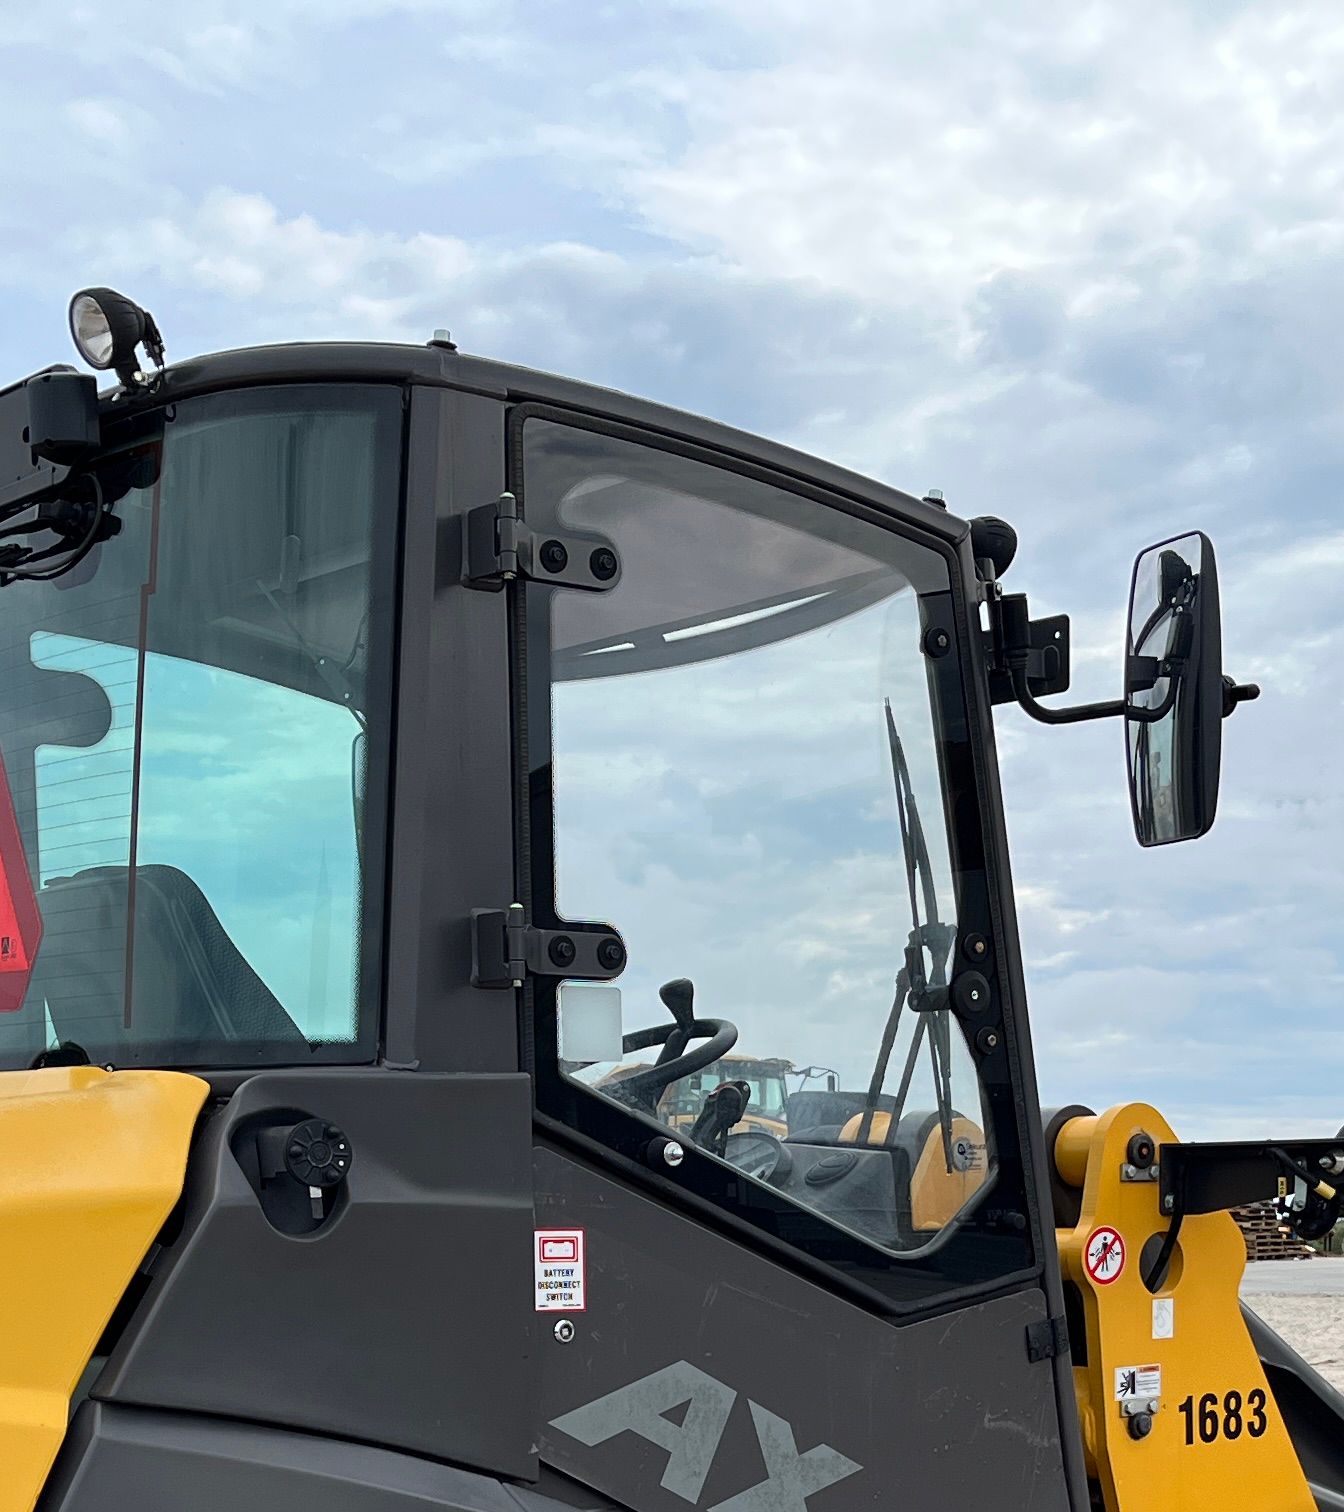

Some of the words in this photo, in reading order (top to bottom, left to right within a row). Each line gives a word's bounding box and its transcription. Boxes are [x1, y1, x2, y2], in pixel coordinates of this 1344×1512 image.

[544, 1269, 574, 1277] BATTERY
[538, 1281, 580, 1289] DISCONNECT
[546, 1292, 573, 1301] SWITCH
[1178, 1389, 1267, 1446] 1683
